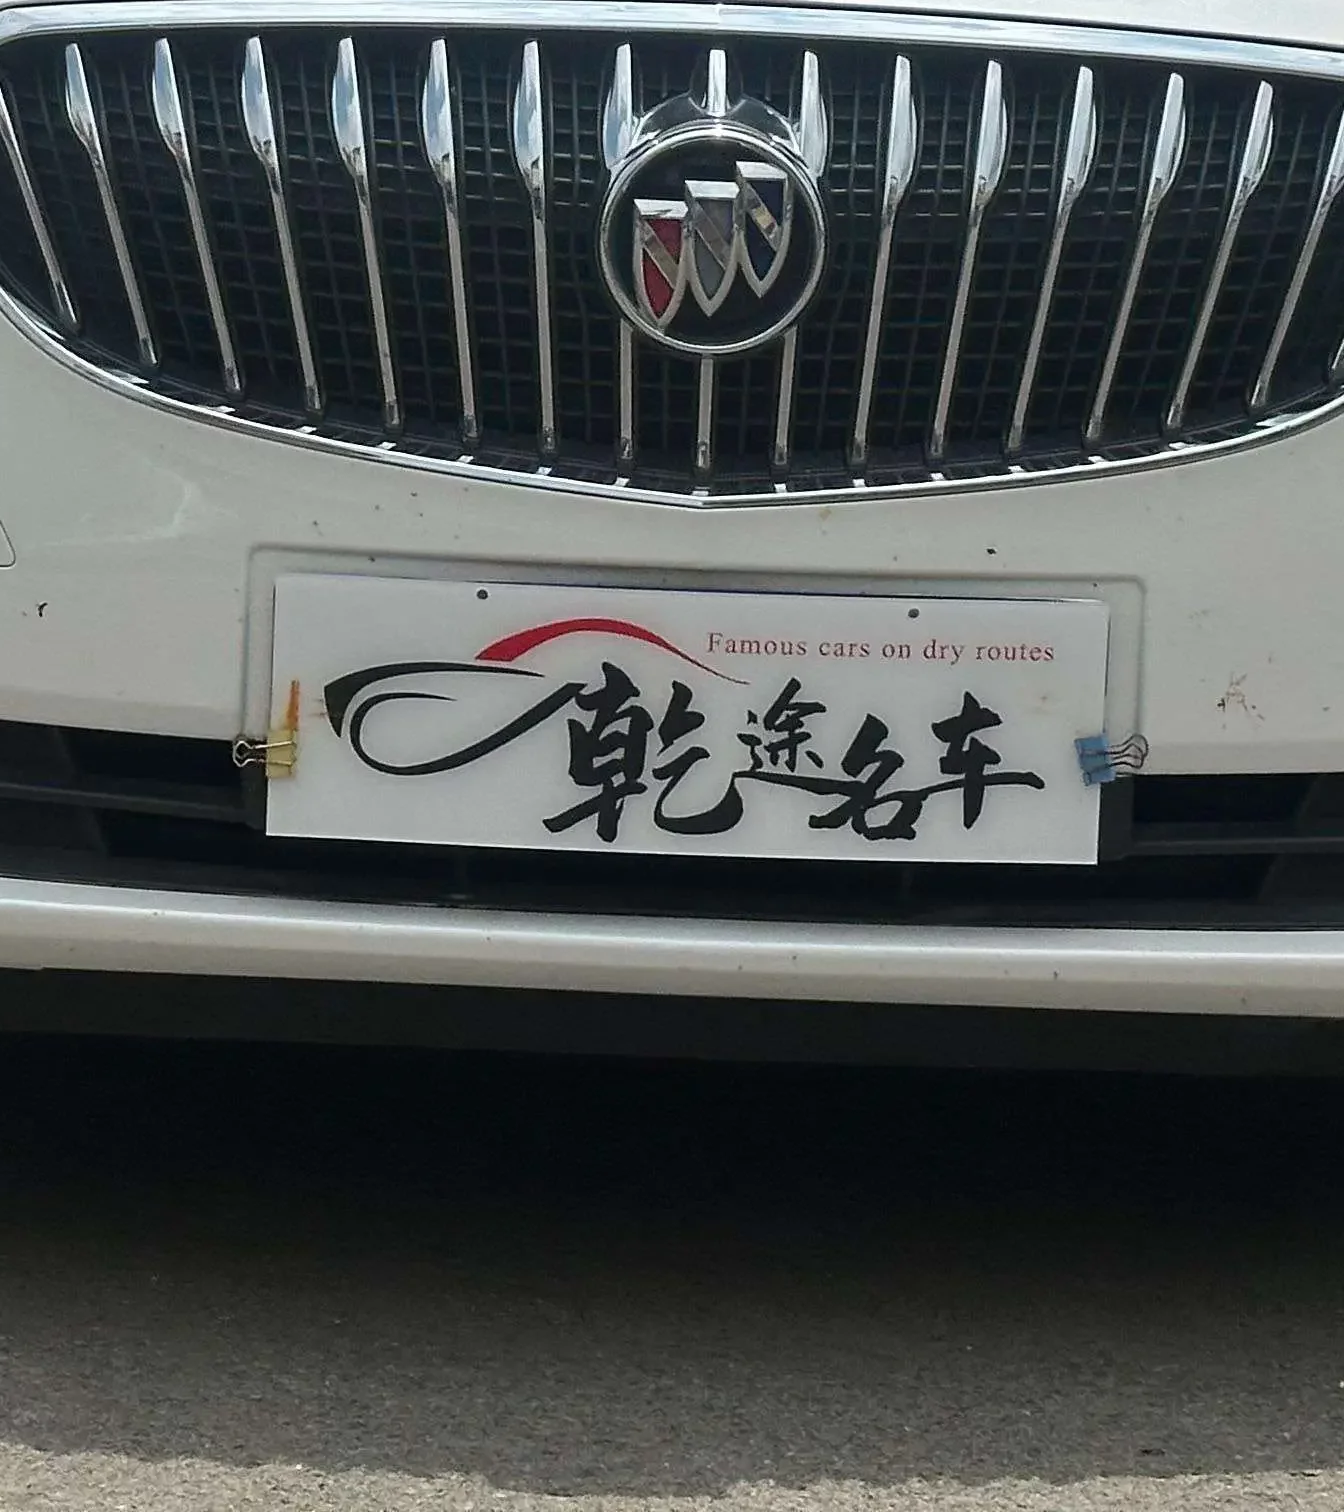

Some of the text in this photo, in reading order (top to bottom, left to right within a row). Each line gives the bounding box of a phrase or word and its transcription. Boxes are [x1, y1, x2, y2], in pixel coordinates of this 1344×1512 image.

[707, 631, 1056, 666] Famous cars on dry routes
[542, 661, 1046, 843] 乾途名车
